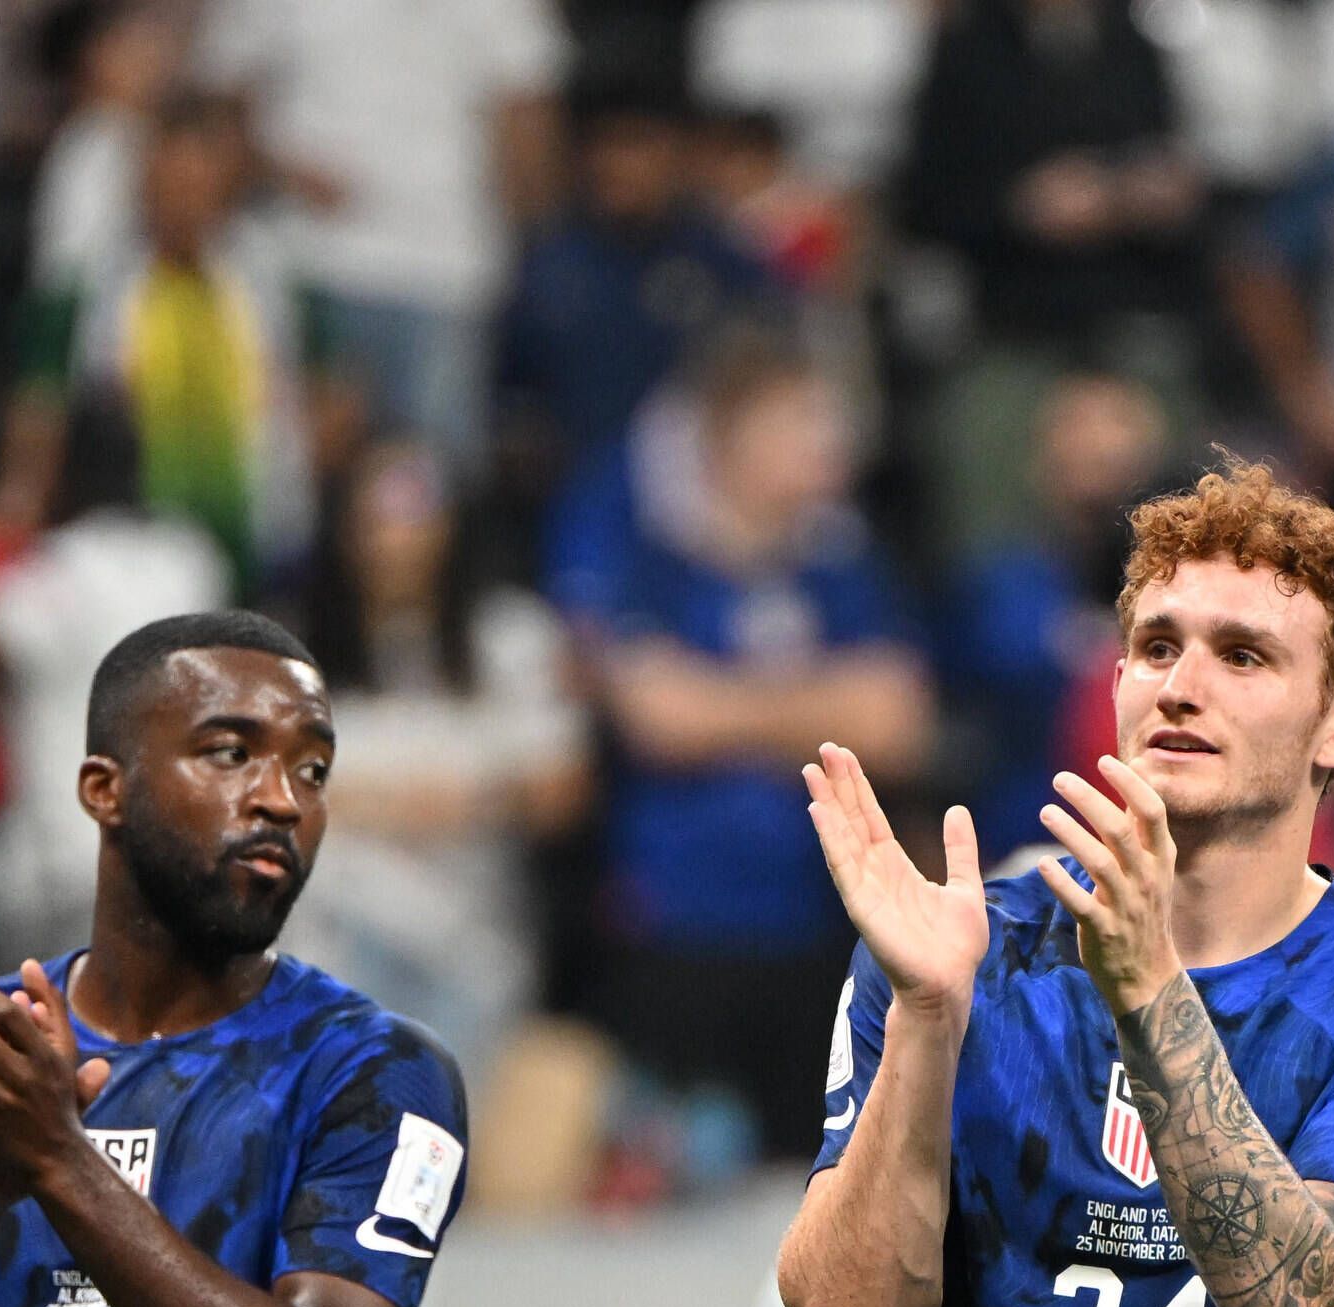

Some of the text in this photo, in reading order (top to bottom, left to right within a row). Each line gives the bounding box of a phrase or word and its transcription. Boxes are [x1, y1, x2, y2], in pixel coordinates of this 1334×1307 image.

[91, 1138, 148, 1172] SA
[1087, 1201, 1169, 1223] ENGLAND VS.
[1089, 1219, 1105, 1236] AL
[1110, 1223, 1147, 1243] KHOR,
[1076, 1236, 1188, 1260] 25 NOVEMBER 20
